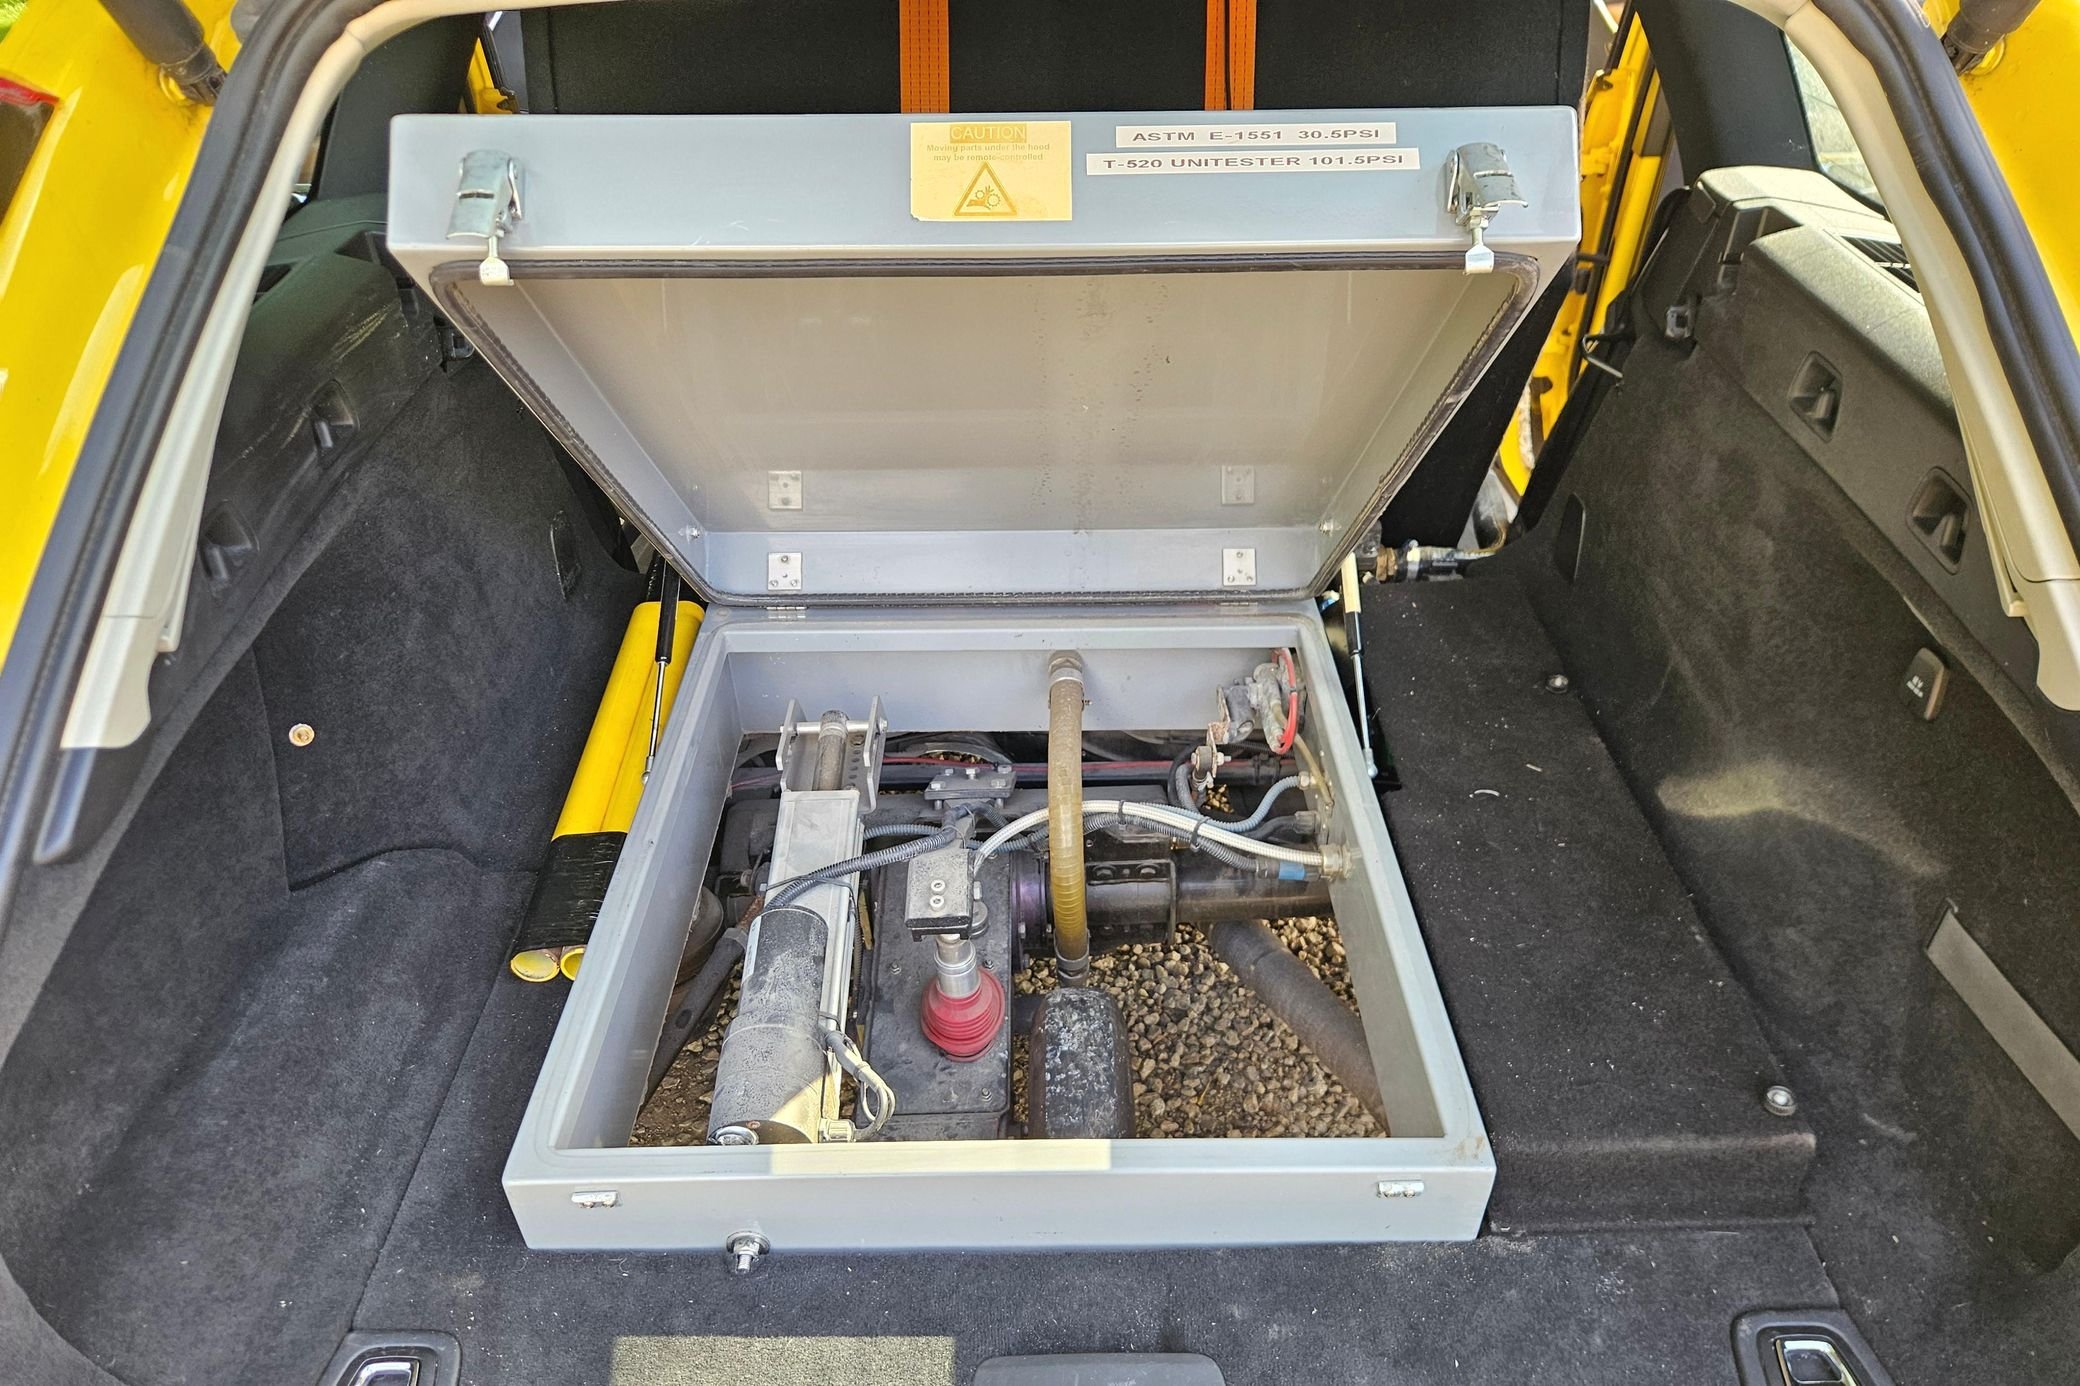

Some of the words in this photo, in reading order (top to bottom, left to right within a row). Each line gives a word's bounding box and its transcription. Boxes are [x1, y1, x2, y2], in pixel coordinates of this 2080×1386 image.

[950, 126, 1025, 140] CAUTION
[1132, 132, 1194, 141] ASTM
[1209, 131, 1281, 140] E-1551
[1298, 129, 1379, 139] 30.5PSI
[966, 153, 1043, 161] remote-controlled
[1103, 159, 1162, 168] T-520
[1171, 157, 1301, 168] UNITESTER
[1309, 155, 1403, 165] 101.5PSI
